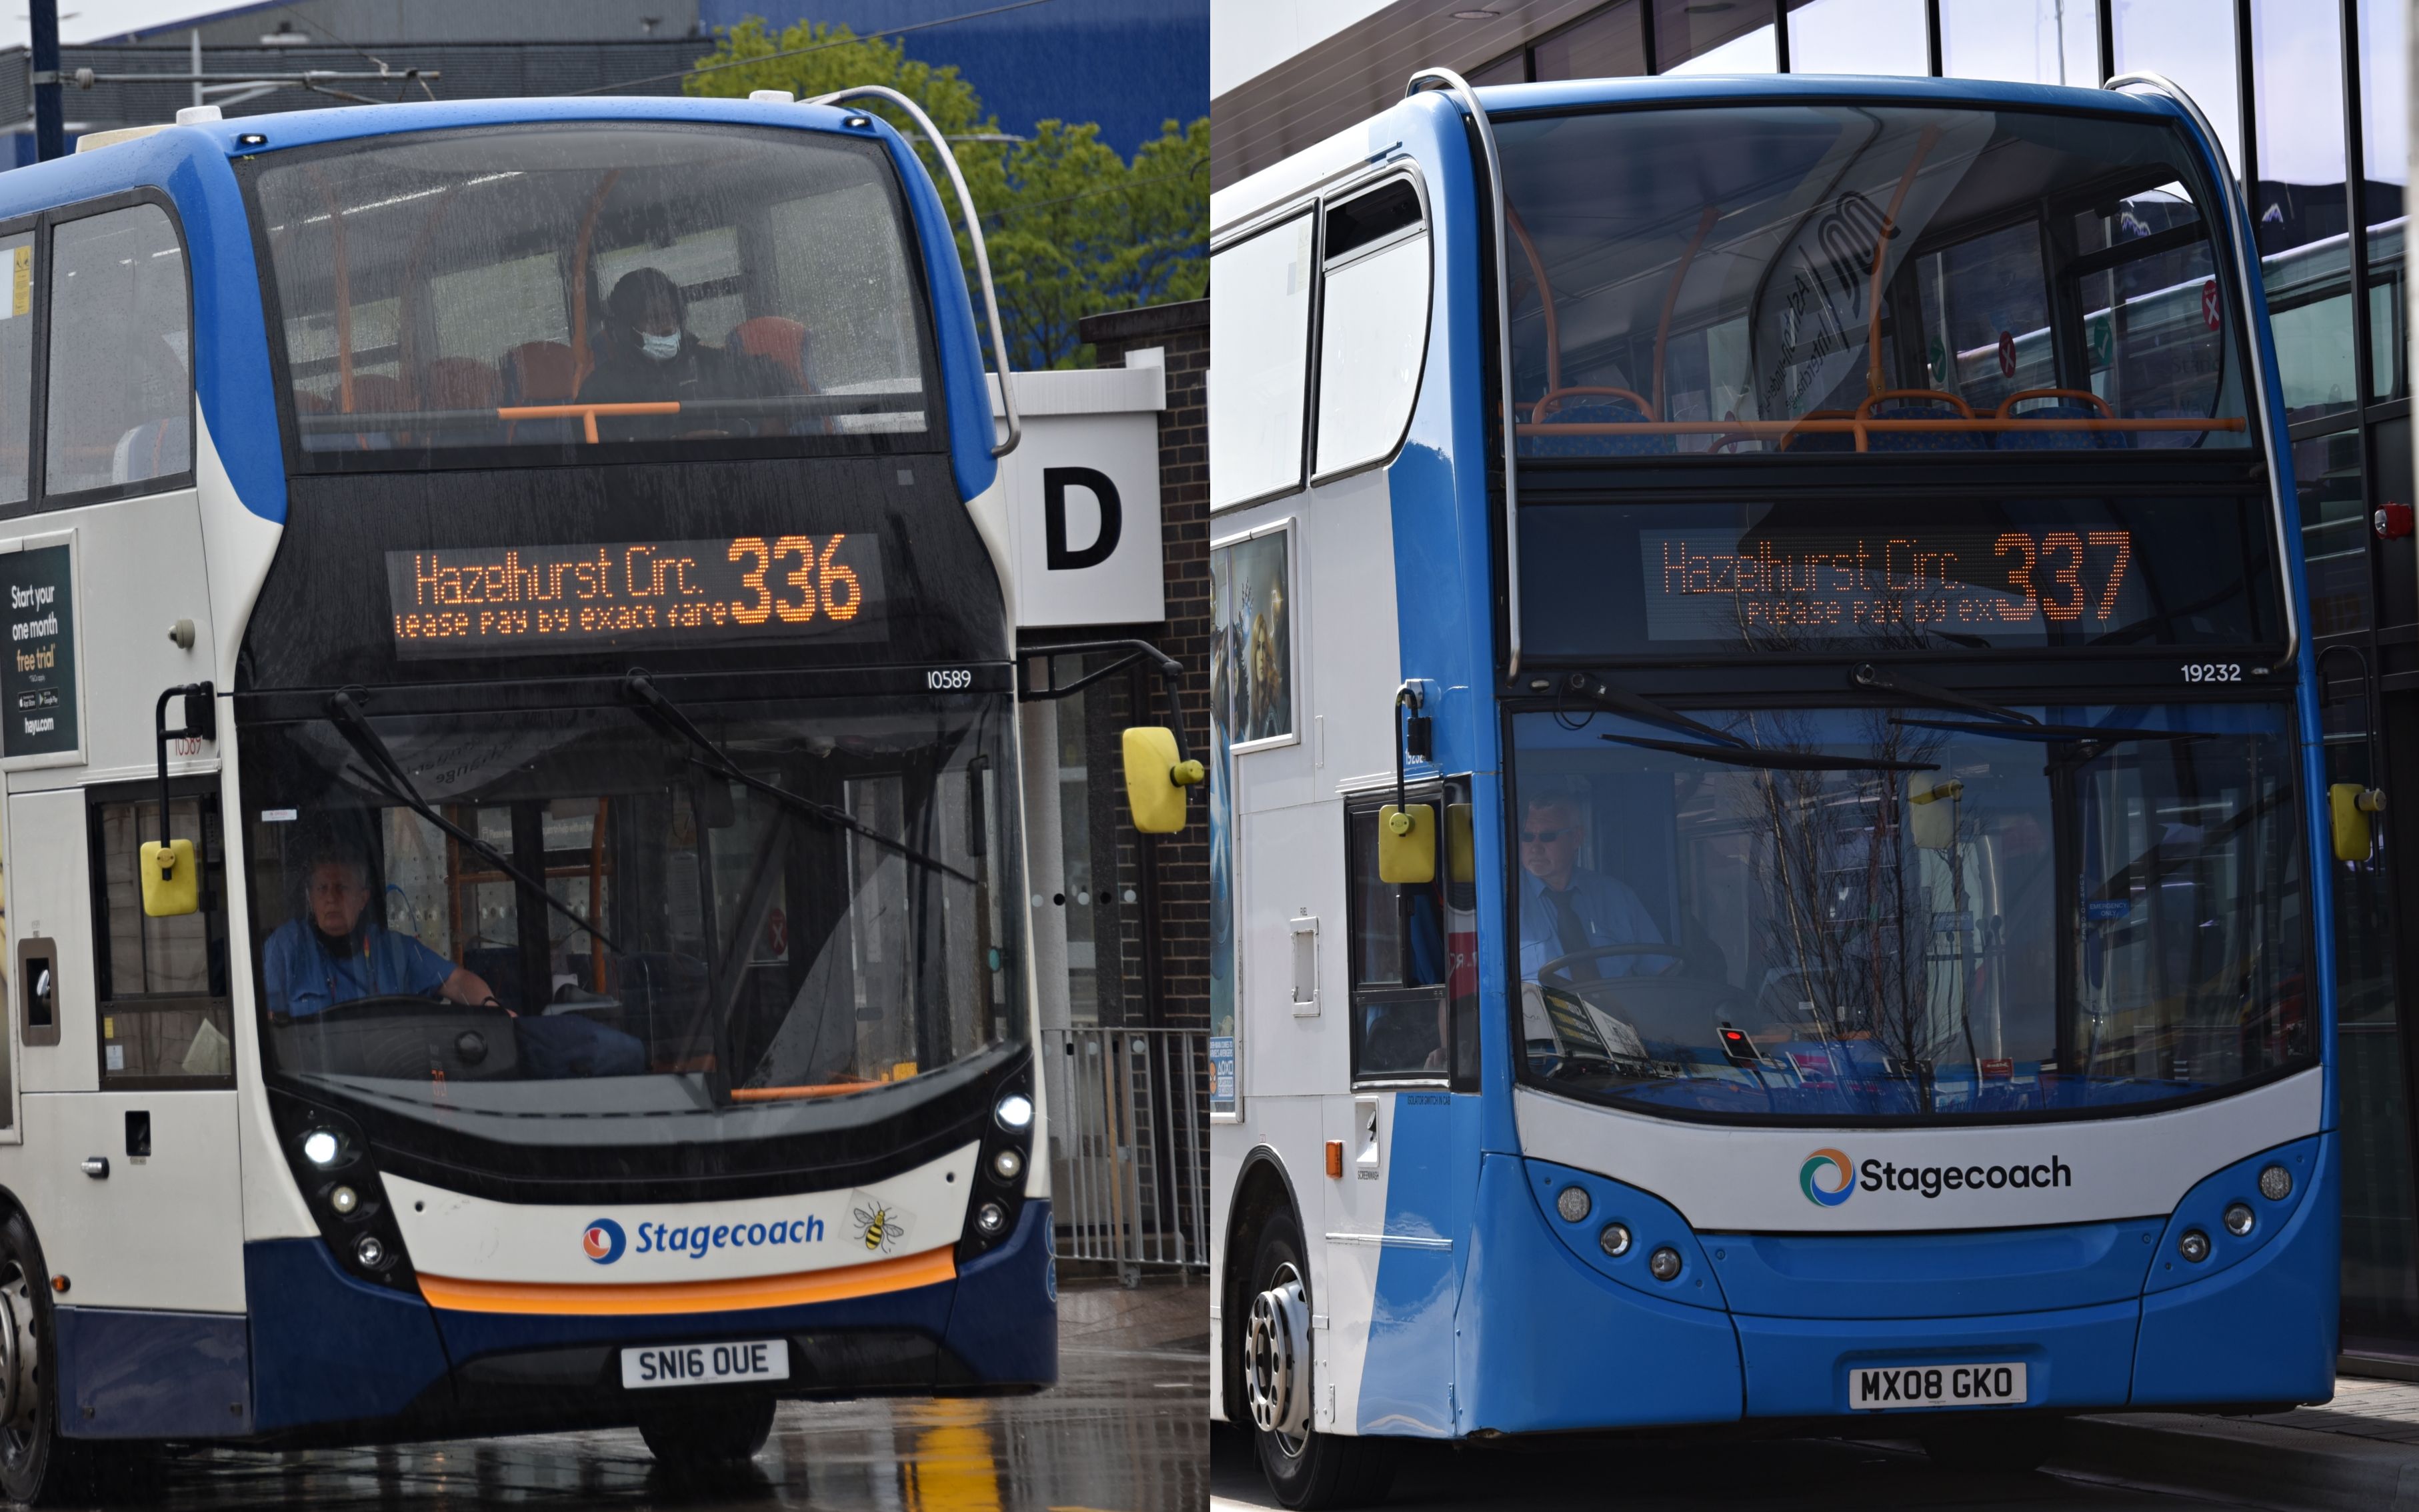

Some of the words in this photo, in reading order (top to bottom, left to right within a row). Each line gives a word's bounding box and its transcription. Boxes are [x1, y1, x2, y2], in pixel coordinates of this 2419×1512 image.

[1043, 467, 1123, 571] D
[416, 549, 611, 605] Hazelhurst
[625, 546, 703, 596] Circ.
[727, 533, 861, 624] 336
[1664, 540, 1870, 593] Hazelhurst
[1886, 539, 1966, 590] Circ.
[1995, 531, 2130, 621] 337
[11, 585, 33, 609] Start
[34, 585, 55, 612] your
[1748, 601, 1841, 625] Please
[1914, 599, 1946, 623] by
[12, 623, 29, 641] one
[29, 611, 58, 637] month
[538, 607, 569, 633] by
[580, 604, 656, 631] exact
[667, 602, 727, 628] fare
[17, 649, 35, 672] free
[2181, 663, 2242, 682] 19232
[927, 669, 971, 690] 10589
[25, 717, 54, 736] hayu.com
[2089, 902, 2127, 910] EMERGENCY
[1358, 1170, 1380, 1181] SCREENWASH
[1860, 1155, 2072, 1199] Stagecoach
[635, 1214, 824, 1259] Stagecoach
[639, 1349, 705, 1381] SN16
[713, 1344, 769, 1375] OUE
[1862, 1369, 1942, 1401] MX08
[1953, 1367, 2012, 1399] GKO
